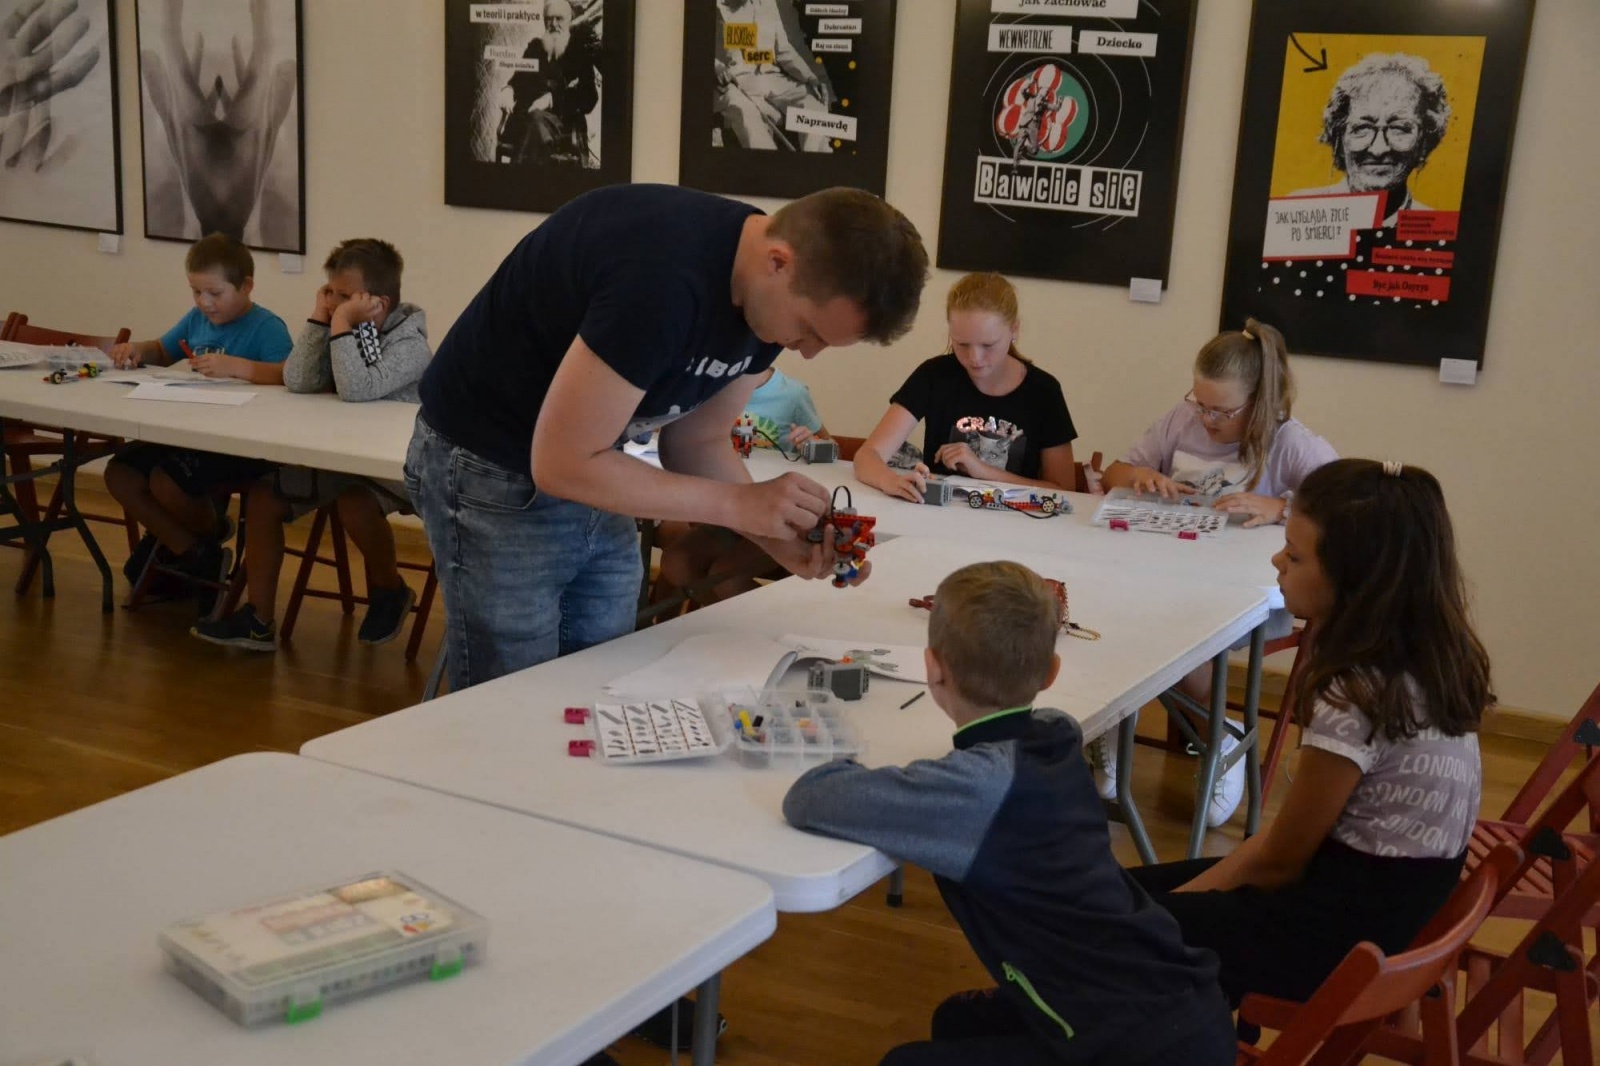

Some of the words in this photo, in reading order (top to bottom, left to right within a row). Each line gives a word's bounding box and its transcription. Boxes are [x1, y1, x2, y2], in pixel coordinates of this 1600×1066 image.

[507, 10, 541, 22] praktyce
[1096, 36, 1143, 49] Dziecko
[747, 51, 770, 62] serc
[795, 114, 849, 132] Naprawdę
[979, 163, 1081, 205] Bawcie
[1091, 173, 1136, 207] się
[1275, 211, 1289, 225] JAK
[1291, 226, 1302, 241] PO
[1312, 700, 1361, 737] NYC
[1398, 752, 1467, 784] LONDON
[1373, 781, 1450, 813] ONDON
